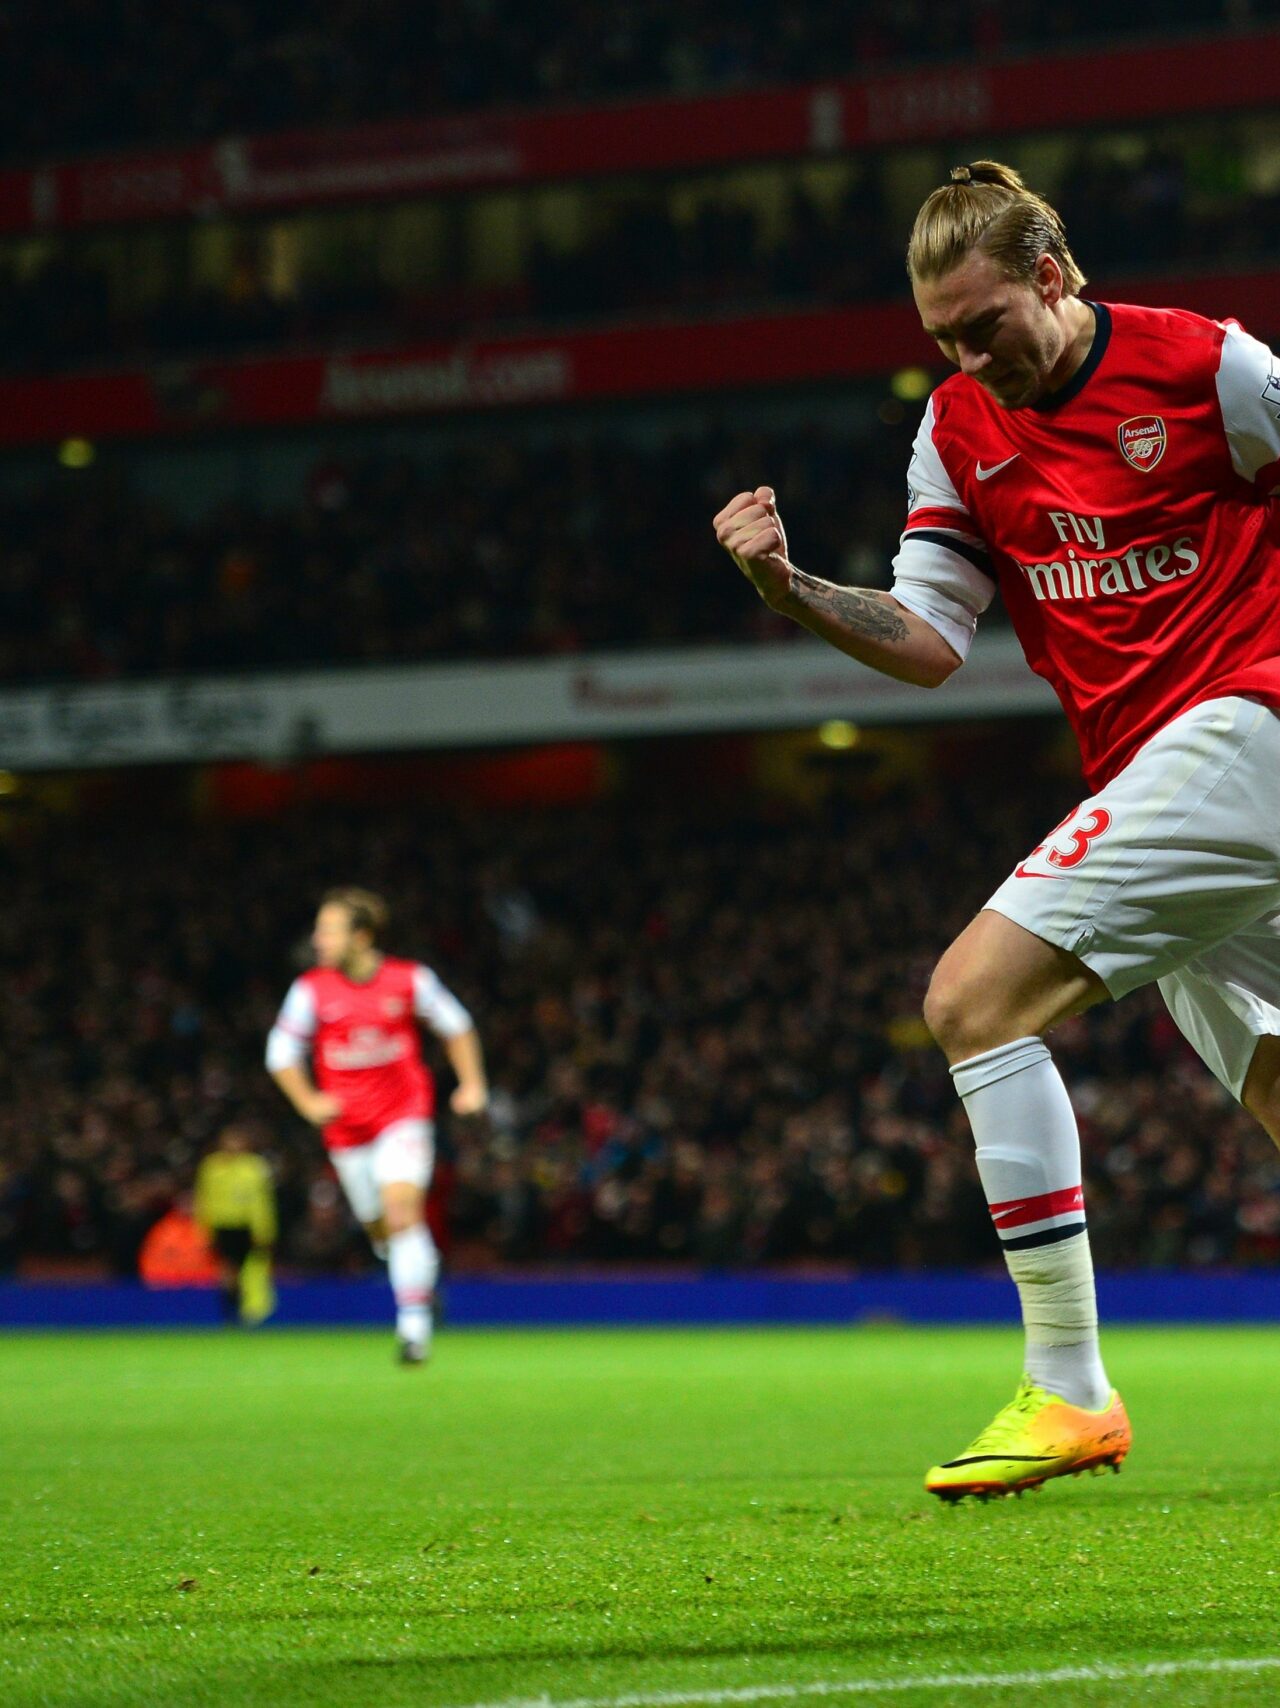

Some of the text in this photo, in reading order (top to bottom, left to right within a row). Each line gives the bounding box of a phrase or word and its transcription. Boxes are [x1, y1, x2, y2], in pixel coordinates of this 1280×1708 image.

[1124, 423, 1159, 439] Arsenal
[1047, 511, 1106, 551] Fly
[1011, 536, 1201, 600] mirates
